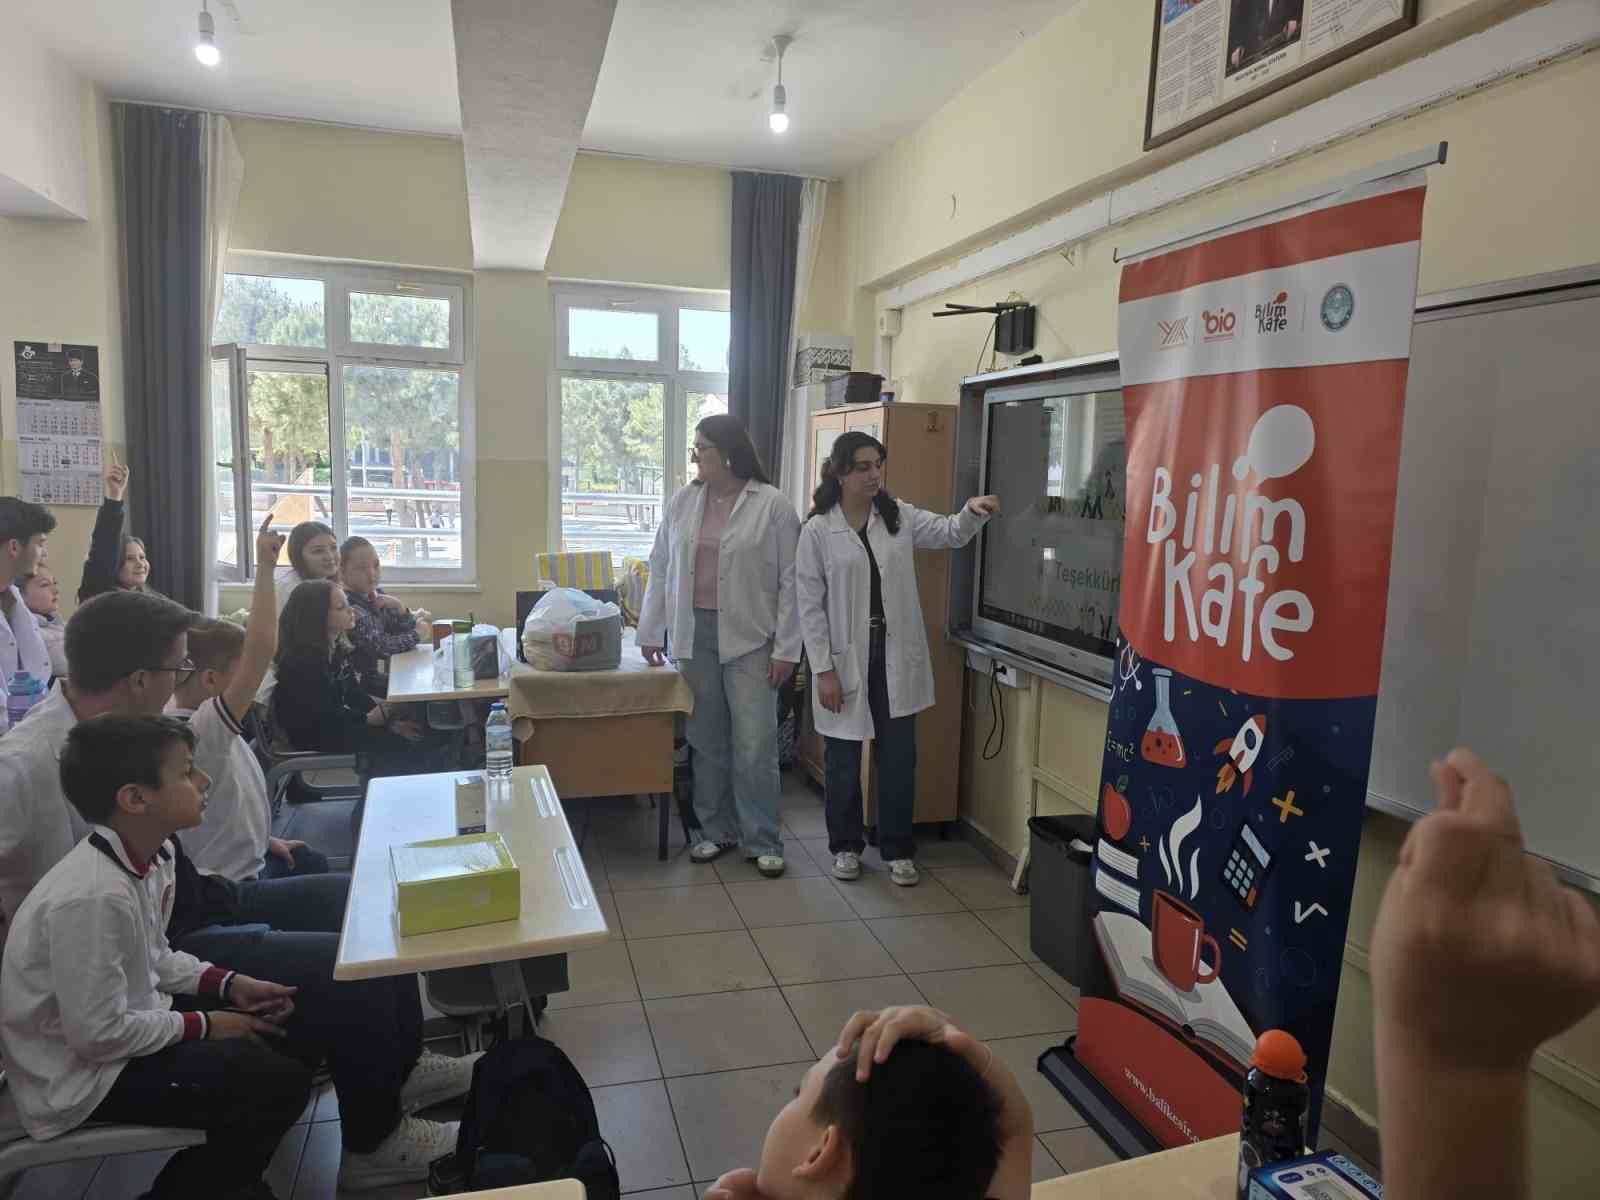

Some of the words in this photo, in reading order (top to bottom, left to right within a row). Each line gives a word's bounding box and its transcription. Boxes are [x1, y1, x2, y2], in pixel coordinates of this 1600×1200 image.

[1203, 308, 1236, 334] bio
[1255, 300, 1287, 318] Bilim
[1258, 312, 1287, 334] Kafe
[1146, 456, 1307, 562] Bilim
[1163, 538, 1315, 662] Kafe
